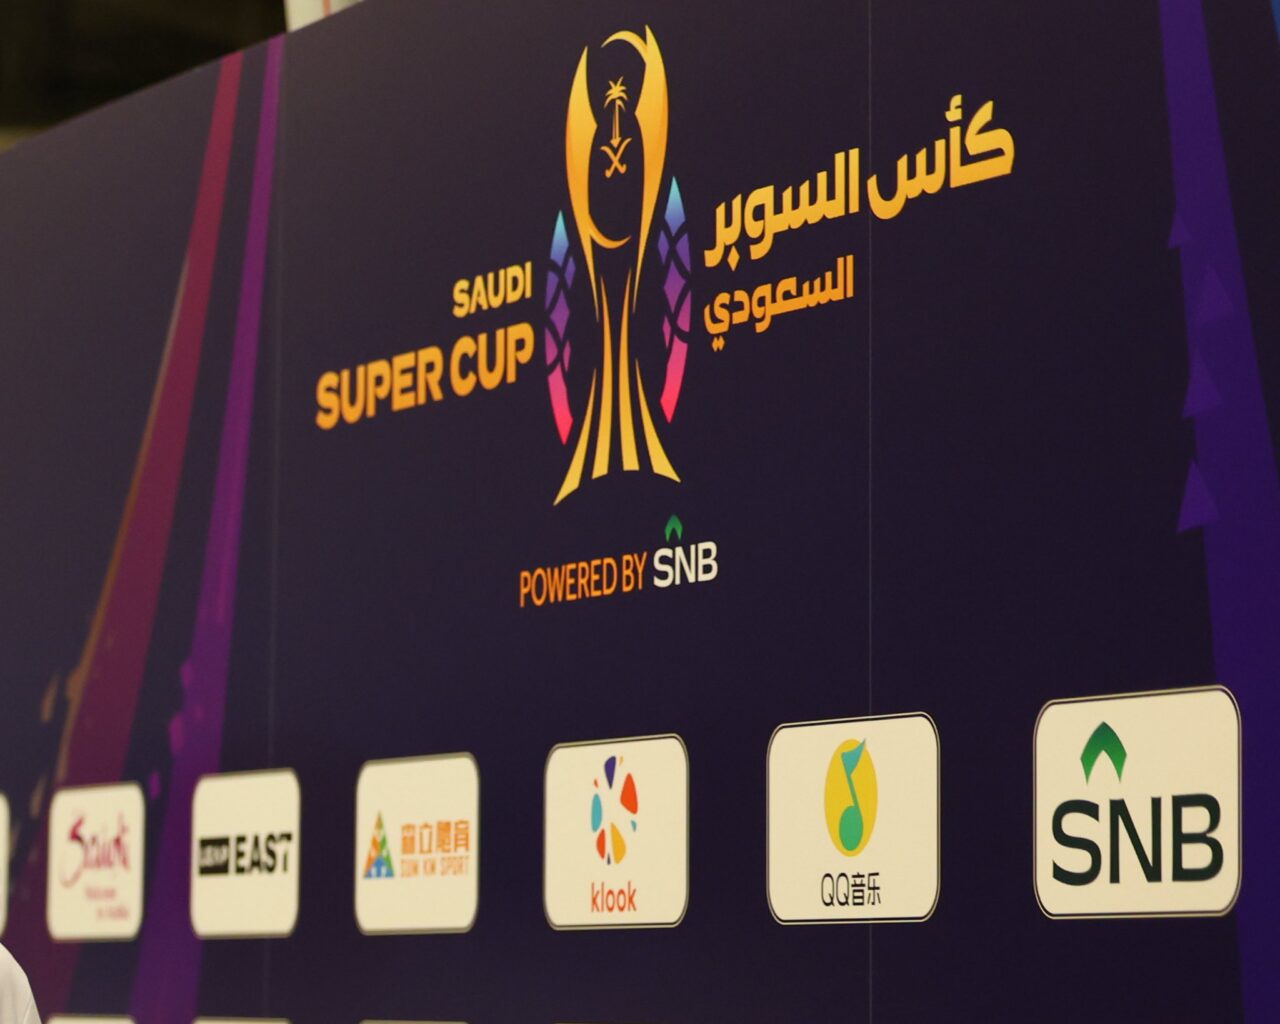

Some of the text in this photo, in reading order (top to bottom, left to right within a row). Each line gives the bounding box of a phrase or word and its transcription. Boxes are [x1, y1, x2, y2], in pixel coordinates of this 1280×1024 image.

[704, 95, 1015, 271] كأس السوبر
[452, 261, 532, 318] SAUDI
[704, 255, 854, 352] السعودي
[316, 322, 535, 430] SUPER CUP
[520, 541, 718, 607] POWERED BY SNB
[236, 832, 292, 874] EAST
[1052, 793, 1223, 886] SNB
[591, 881, 637, 913] klook
[821, 872, 881, 907] QQ音乐
